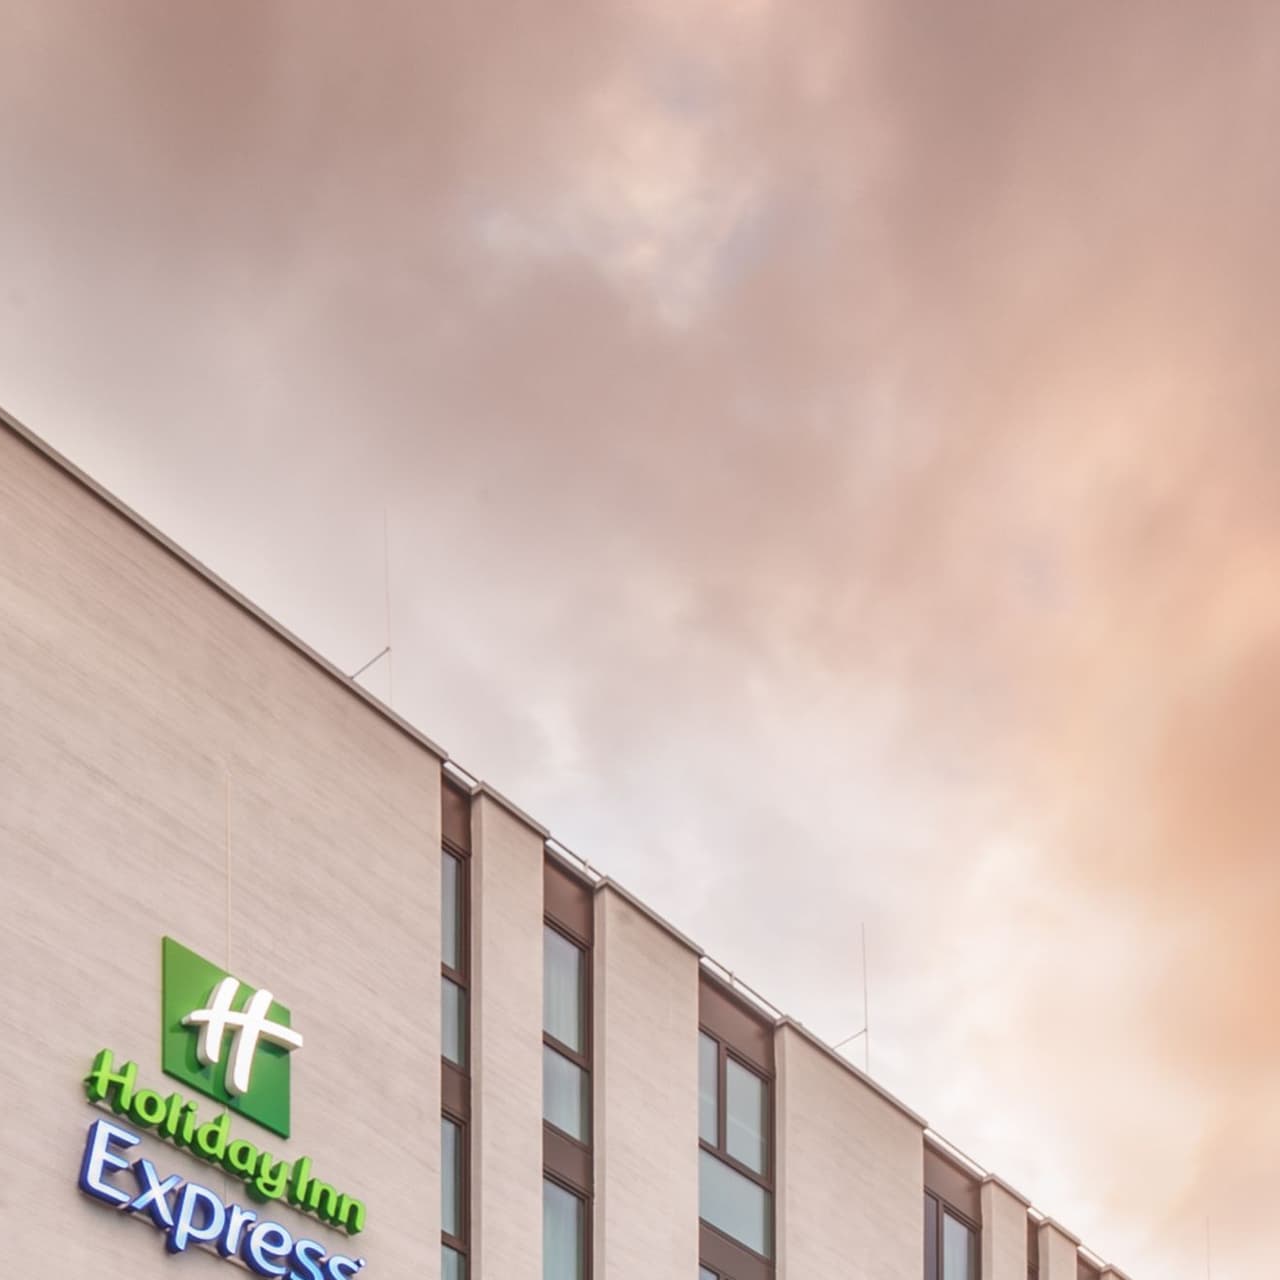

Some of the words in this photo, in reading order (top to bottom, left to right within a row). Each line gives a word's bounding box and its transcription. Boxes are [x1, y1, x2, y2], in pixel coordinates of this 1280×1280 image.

[180, 976, 304, 1097] H
[83, 1048, 289, 1204] Holiday
[289, 1156, 366, 1236] Inn
